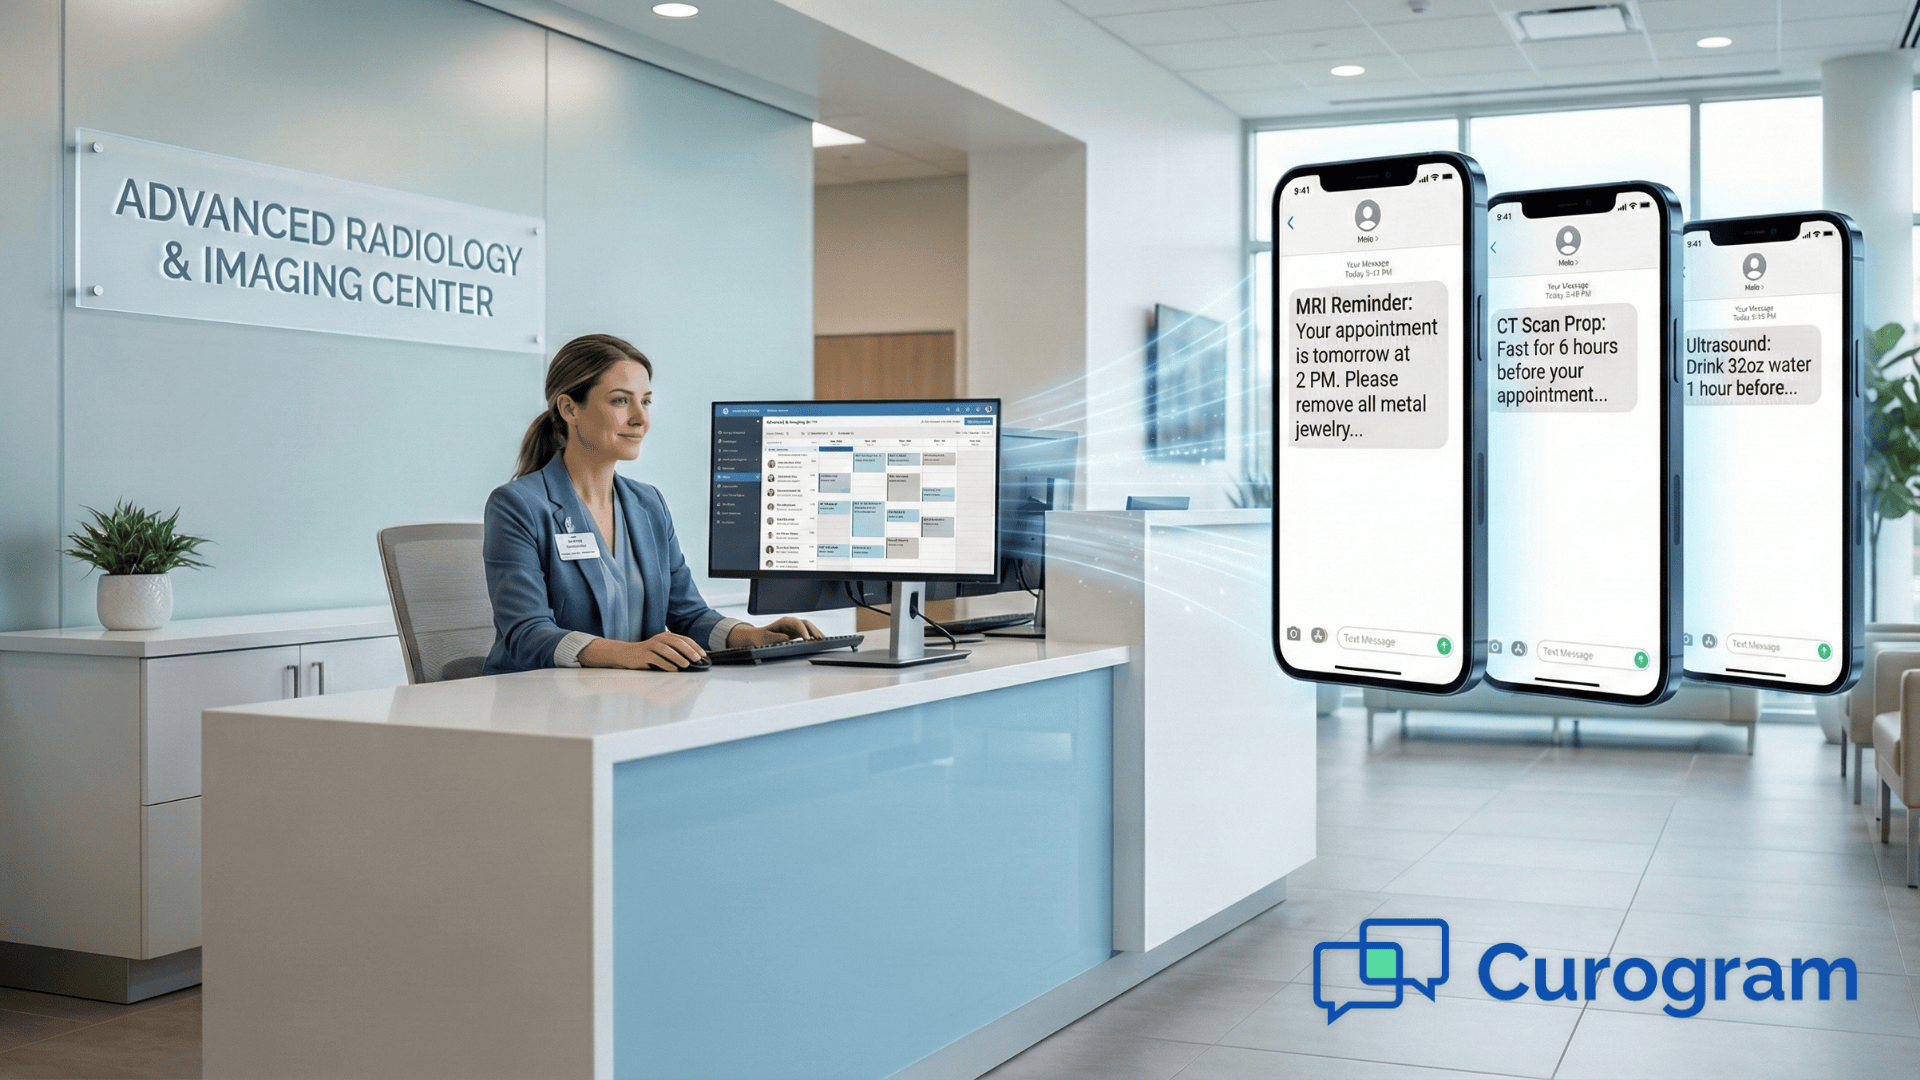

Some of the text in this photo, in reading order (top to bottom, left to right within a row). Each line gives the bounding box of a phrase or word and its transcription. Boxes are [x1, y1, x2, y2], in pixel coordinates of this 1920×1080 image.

[1294, 186, 1310, 195] 9:41
[1497, 213, 1512, 221] 9:41
[115, 178, 522, 276] ADVANCED RADIOLOGY
[1687, 240, 1701, 248] 9:41
[163, 241, 493, 316] & IMAGING CENTER
[1296, 294, 1412, 314] MRI Reminder:
[1296, 319, 1437, 341] Your appointment
[1497, 316, 1605, 334] CT Scan Prop:
[1498, 338, 1618, 356] Fast for 6 hours
[1687, 335, 1770, 353] Ultrasound:
[1296, 345, 1410, 363] is tomorrow at
[1498, 363, 1584, 383] before your
[1687, 357, 1811, 374] Drink 32oz water
[1296, 370, 1398, 388] 2 PM. Please
[1688, 379, 1797, 396] 1 hour before...
[1296, 395, 1426, 412] remove all metal
[1497, 387, 1608, 407] appointment...
[1295, 421, 1362, 441] jewelry...
[1344, 634, 1395, 647] Text Message
[1733, 640, 1780, 651] Text Message
[1544, 647, 1593, 660] Text Message
